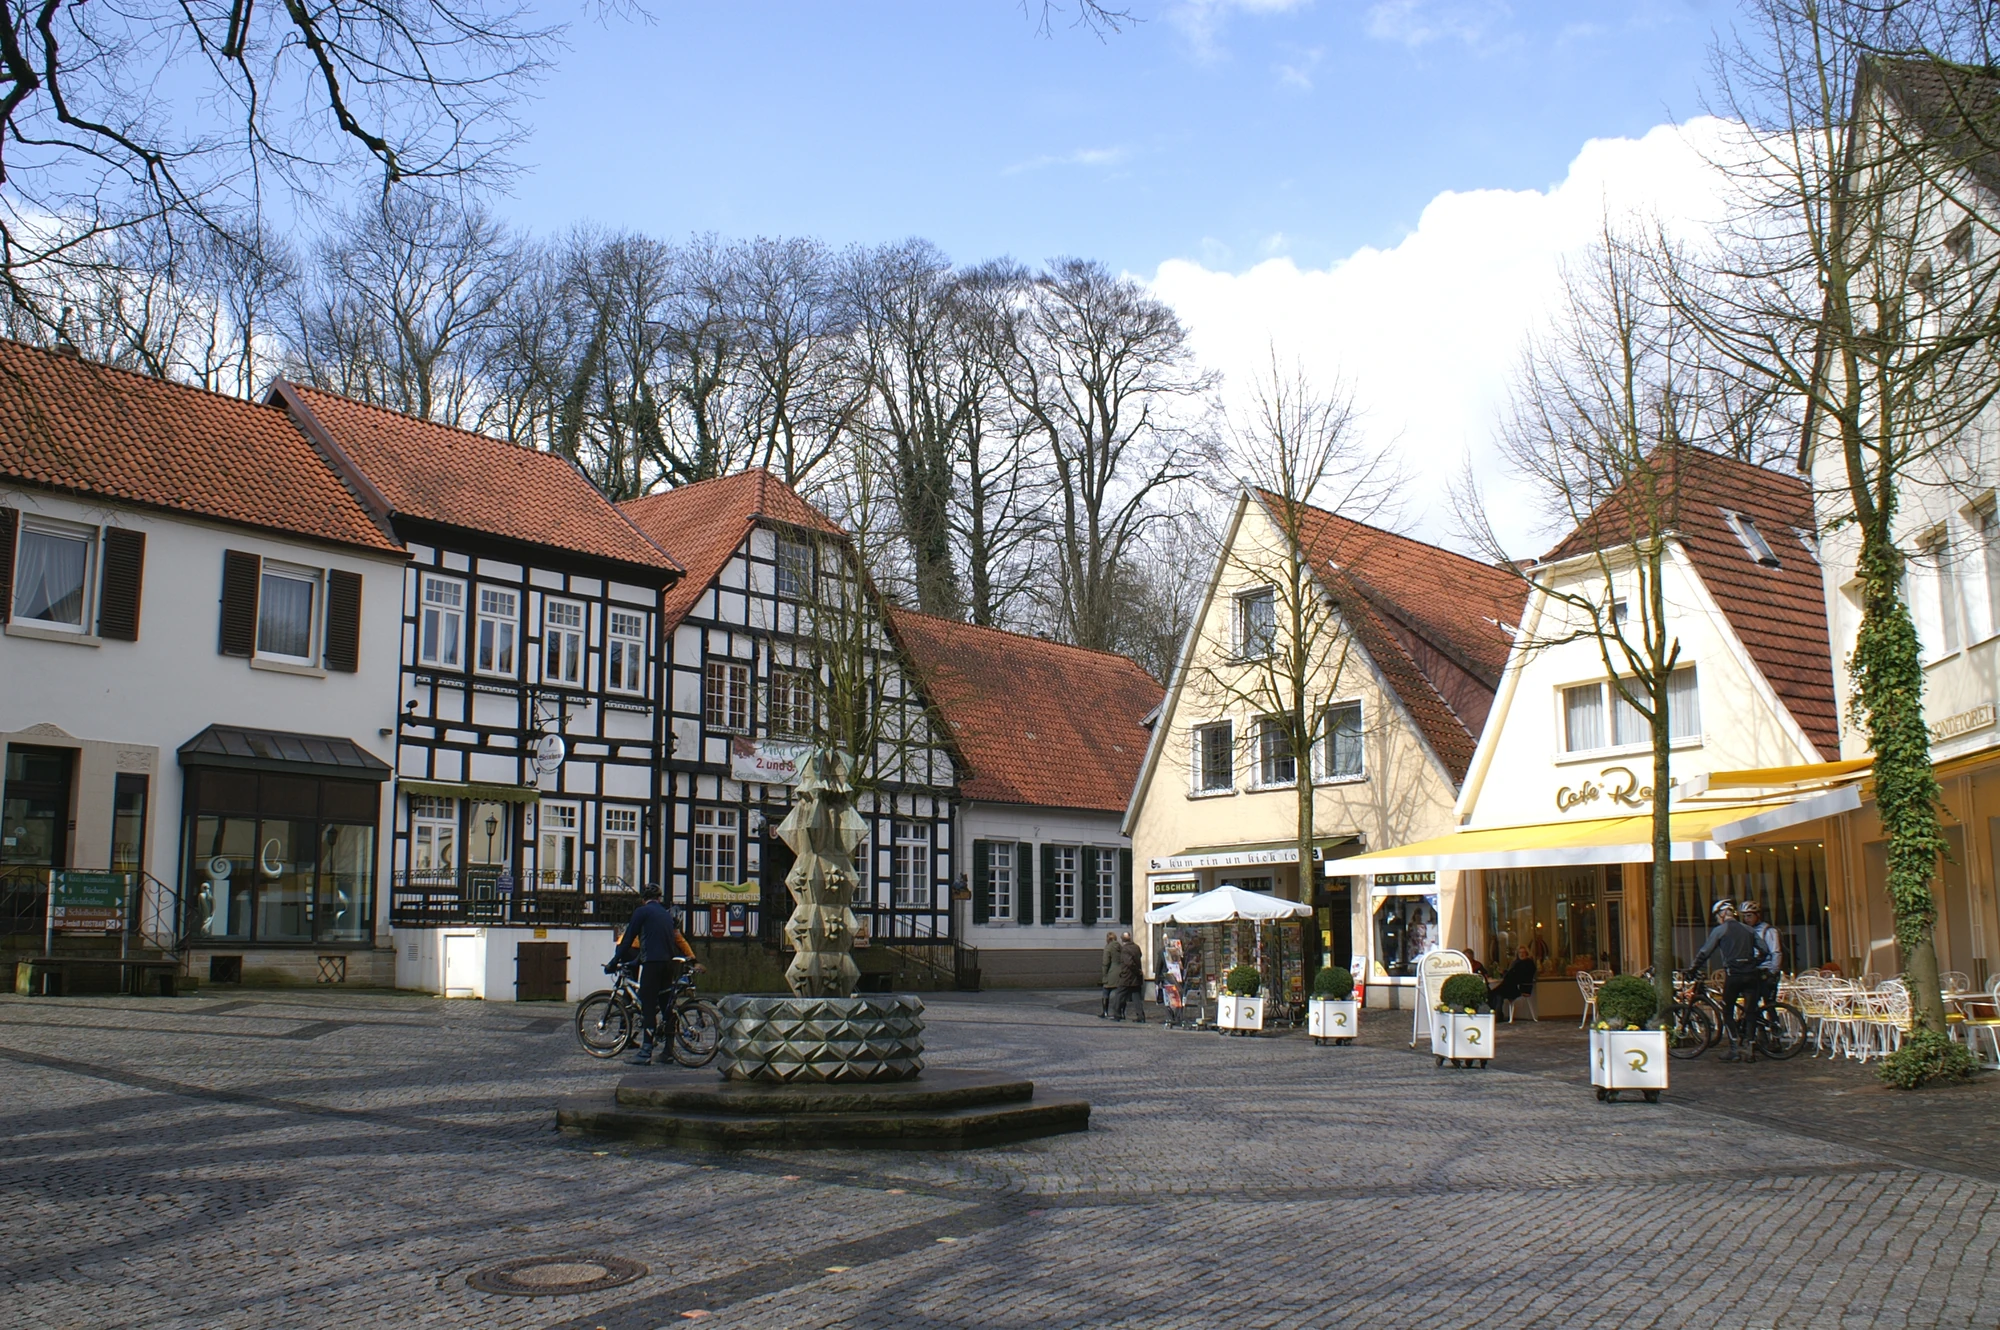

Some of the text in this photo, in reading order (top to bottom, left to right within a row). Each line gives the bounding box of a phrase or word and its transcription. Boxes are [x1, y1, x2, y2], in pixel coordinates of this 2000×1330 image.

[756, 758, 764, 769] 2.
[526, 814, 532, 825] 5
[701, 892, 720, 900] HAUS
[722, 892, 735, 900] DES
